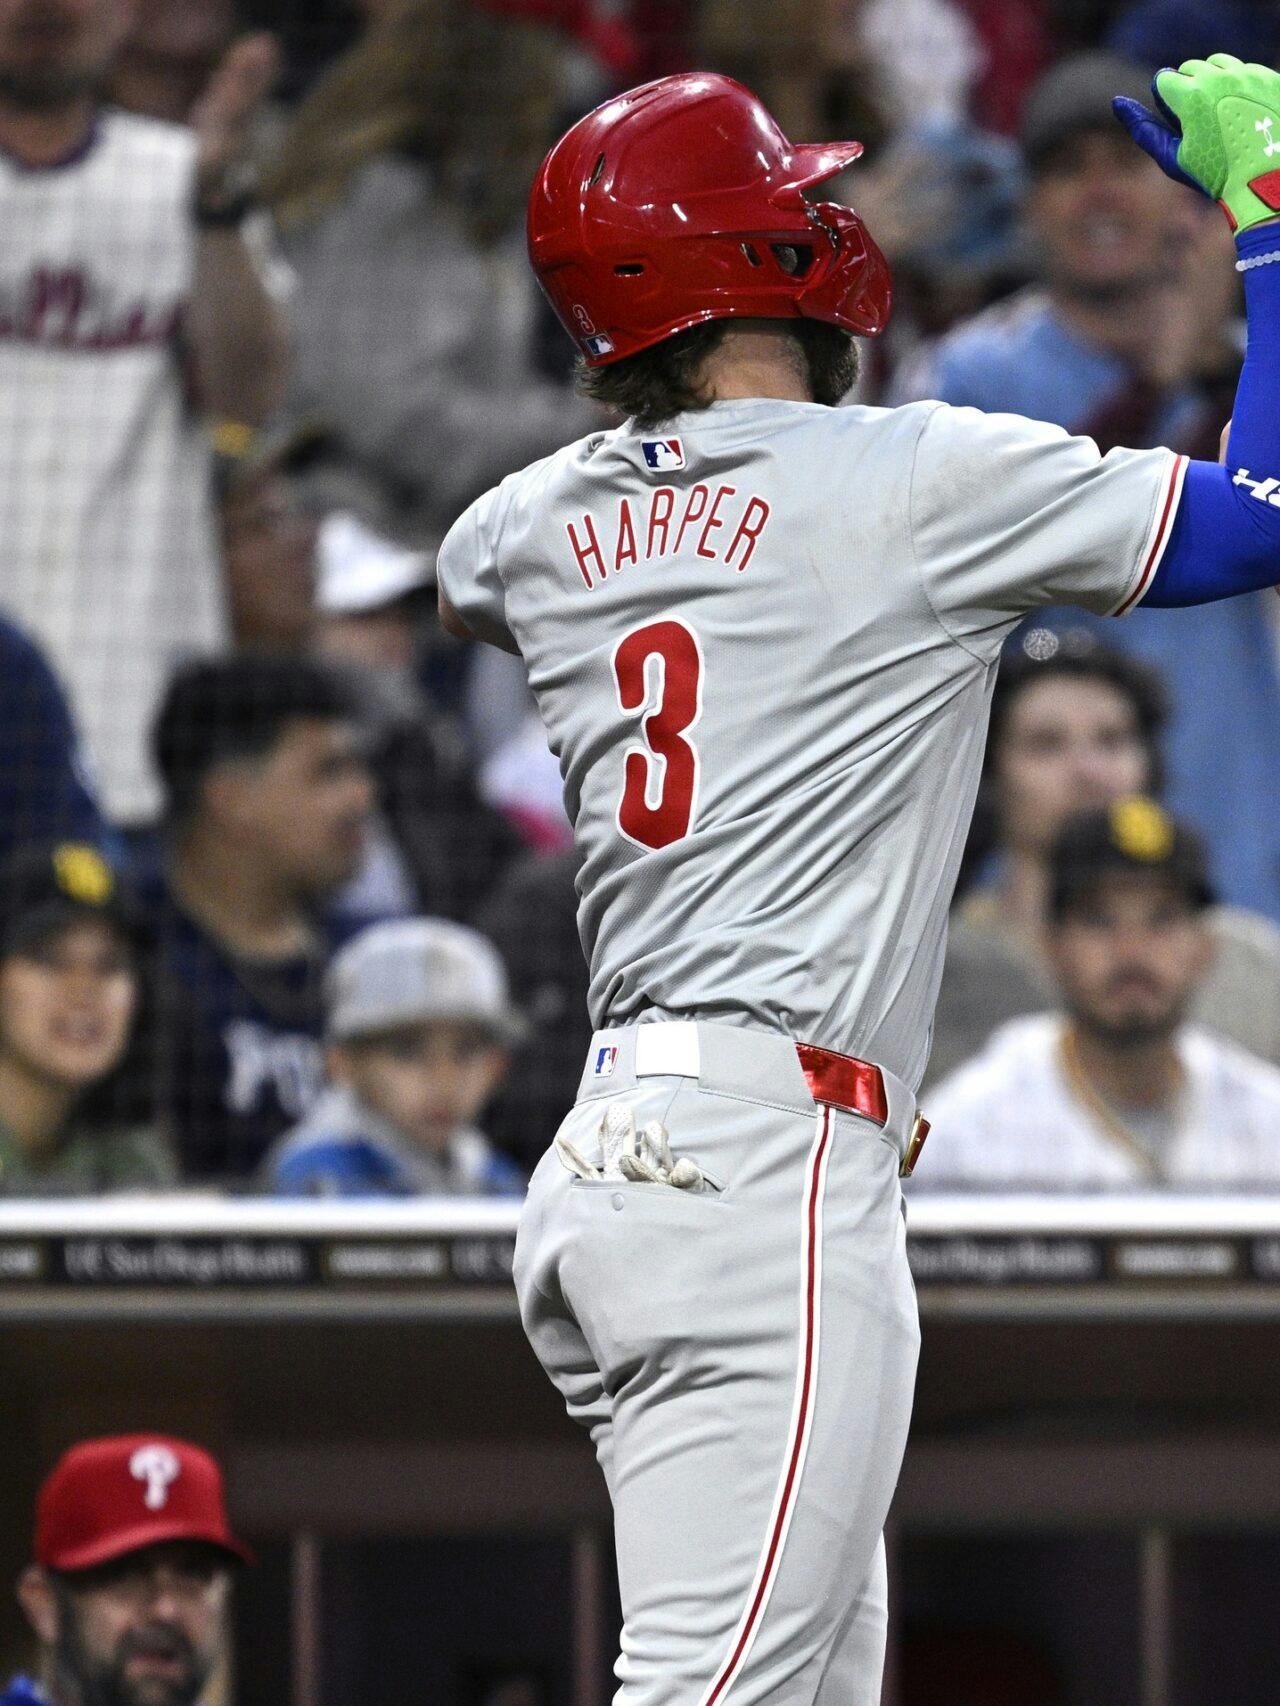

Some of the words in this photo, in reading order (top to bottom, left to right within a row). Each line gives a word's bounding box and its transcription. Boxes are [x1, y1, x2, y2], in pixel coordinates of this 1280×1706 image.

[572, 304, 596, 335] 3
[565, 483, 771, 592] HARPER
[610, 614, 705, 852] 3
[130, 1444, 179, 1510] P
